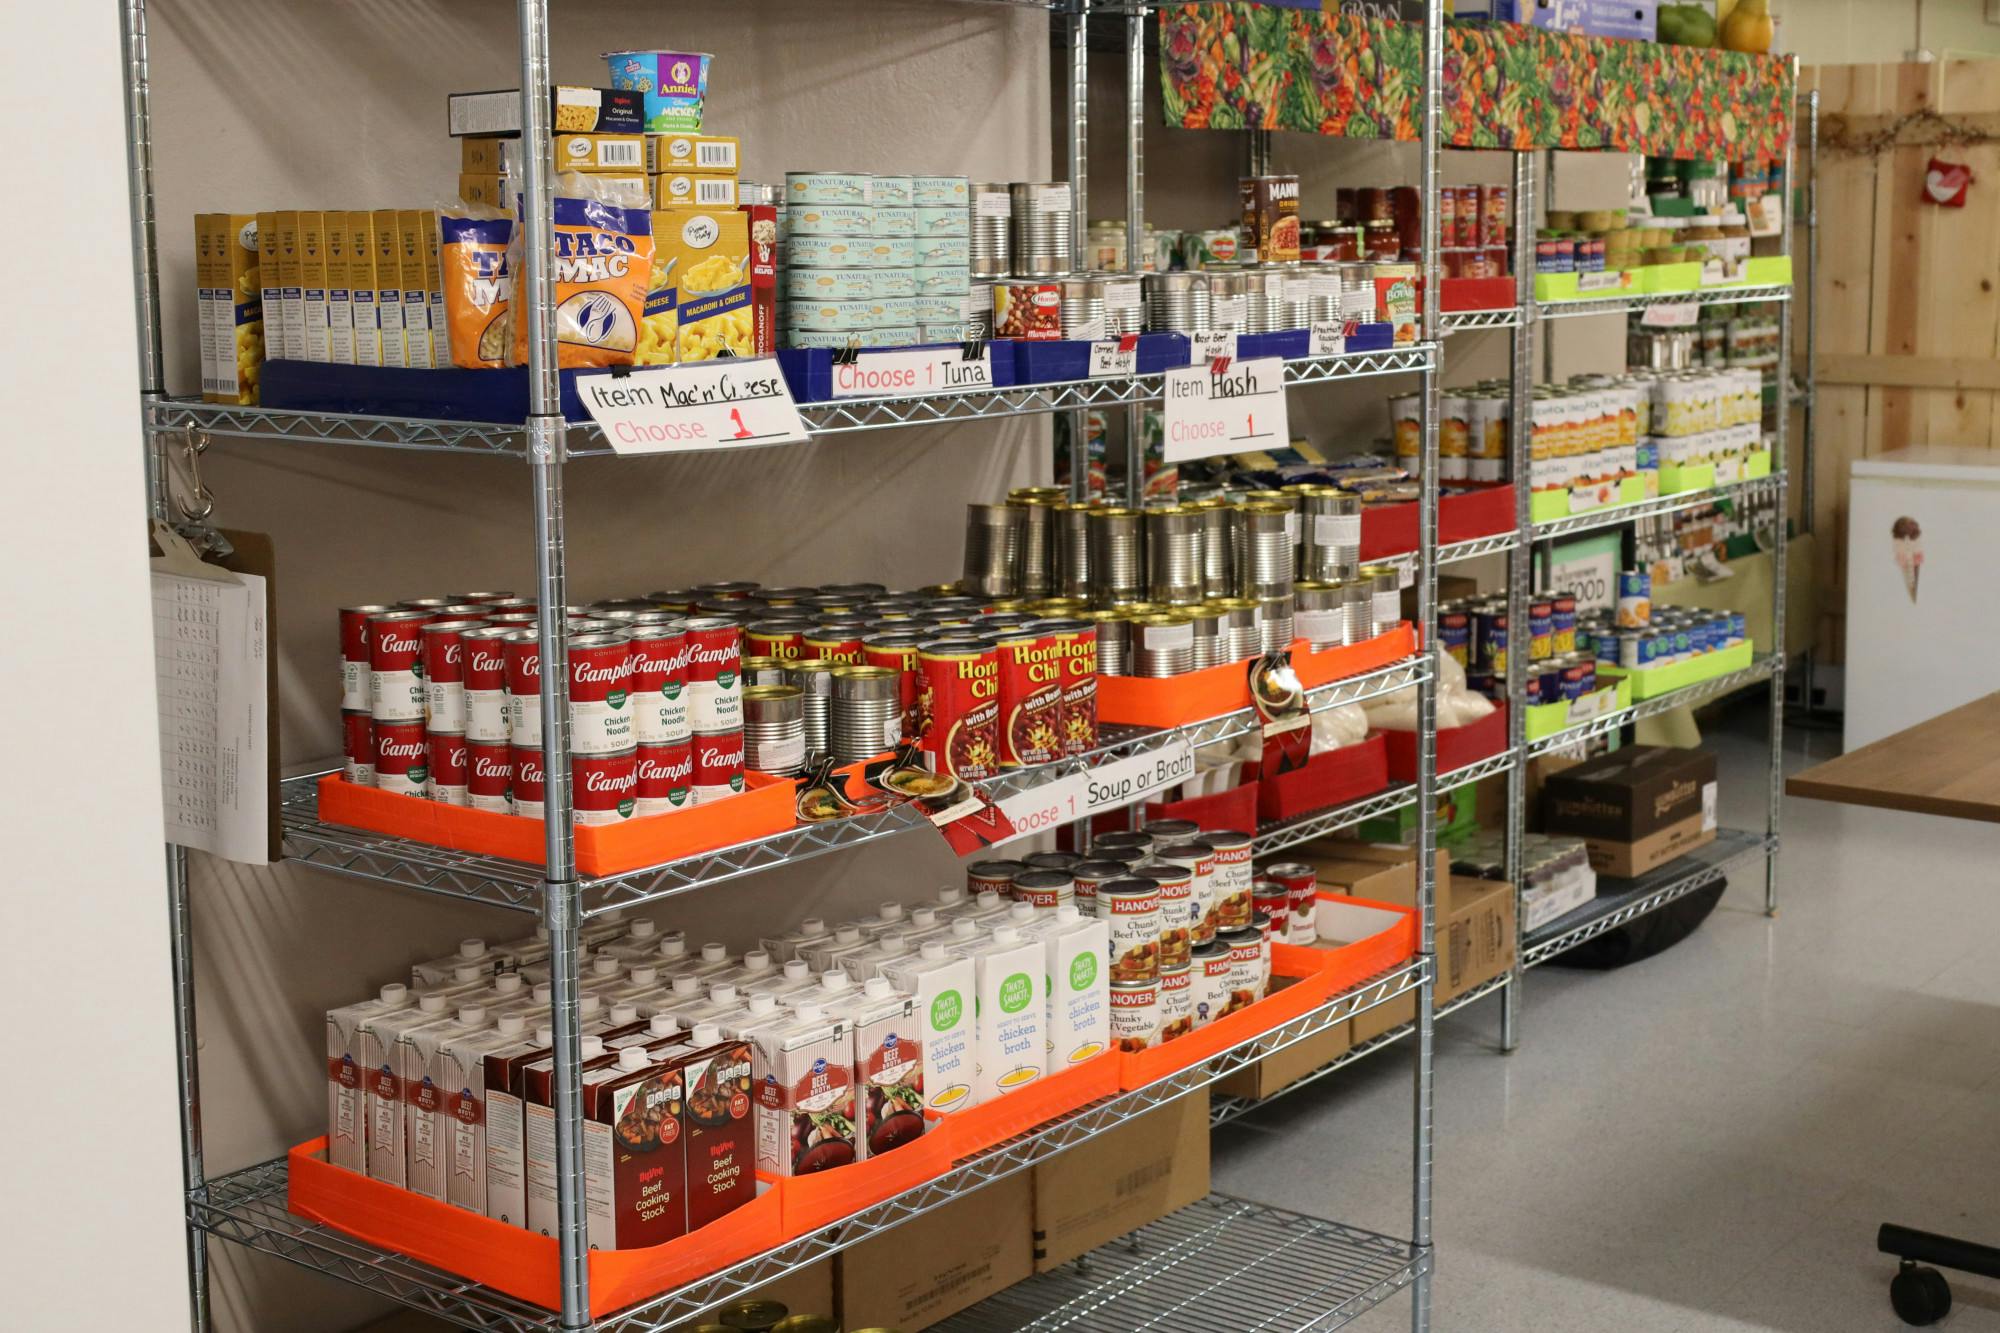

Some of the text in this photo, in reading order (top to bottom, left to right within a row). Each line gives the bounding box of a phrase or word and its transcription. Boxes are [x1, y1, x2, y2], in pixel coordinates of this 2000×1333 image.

[661, 83, 697, 95] Annie's
[612, 107, 633, 116] Original
[662, 107, 696, 117] MICKEY
[809, 178, 853, 186] TUNATURAL
[555, 233, 635, 257] TACO
[555, 256, 629, 283] MAC
[644, 296, 669, 309] CHEESE
[686, 292, 746, 317] MACARONI & CHEESE
[1213, 333, 1228, 342] Beef
[1100, 357, 1112, 368] Beef
[838, 361, 986, 389] Choose 1 Tuna
[1171, 367, 1257, 398] Item Hash
[591, 386, 653, 409] Item
[719, 374, 783, 400] Cese
[614, 408, 753, 444] Choose 1
[1171, 414, 1254, 441] Choose 1
[714, 695, 739, 705] Chicken
[1063, 688, 1083, 703] with
[717, 704, 739, 715] Noodle
[1025, 696, 1045, 711] with
[659, 706, 685, 716] Chicken
[604, 715, 630, 726] Chicken
[661, 715, 685, 726] Noodle
[720, 718, 738, 726] SOUP
[965, 712, 985, 727] with
[606, 725, 630, 736] Noodle
[666, 729, 683, 738] SOUP
[610, 739, 629, 748] SOUP
[1067, 795, 1076, 816] 1
[1088, 779, 1131, 804] Soup
[1137, 770, 1152, 789] or
[1156, 755, 1192, 782] Broth
[1114, 930, 1133, 939] Beef
[1208, 990, 1225, 1000] Beef
[1068, 1000, 1100, 1020] chicken
[1073, 1015, 1096, 1031] broth
[1116, 1021, 1154, 1033] Vegetable
[998, 1023, 1036, 1043] chicken
[931, 1041, 965, 1061] chicken
[1004, 1039, 1031, 1055] broth
[883, 1047, 899, 1061] BEEF
[342, 1064, 353, 1074] BEEF
[882, 1058, 902, 1070] BROTH
[937, 1057, 960, 1074] broth
[339, 1073, 355, 1082] BROTH
[380, 1076, 392, 1086] BEEF
[811, 1074, 828, 1087] BEEF
[377, 1084, 394, 1094] BROTH
[421, 1087, 432, 1097] BEEF
[764, 1086, 776, 1096] BEEF
[810, 1085, 831, 1096] BROTH
[417, 1096, 435, 1106] BROTH
[460, 1099, 472, 1109] BEEF
[761, 1094, 779, 1103] BROTH
[457, 1108, 475, 1117] BROTH
[664, 1123, 674, 1131] FAT
[713, 1155, 732, 1170] Beef
[707, 1165, 740, 1184] Cooking
[642, 1181, 662, 1197] Beef
[713, 1178, 736, 1194] Stock
[635, 1192, 670, 1212] Cooking
[641, 1205, 665, 1221] Stock
